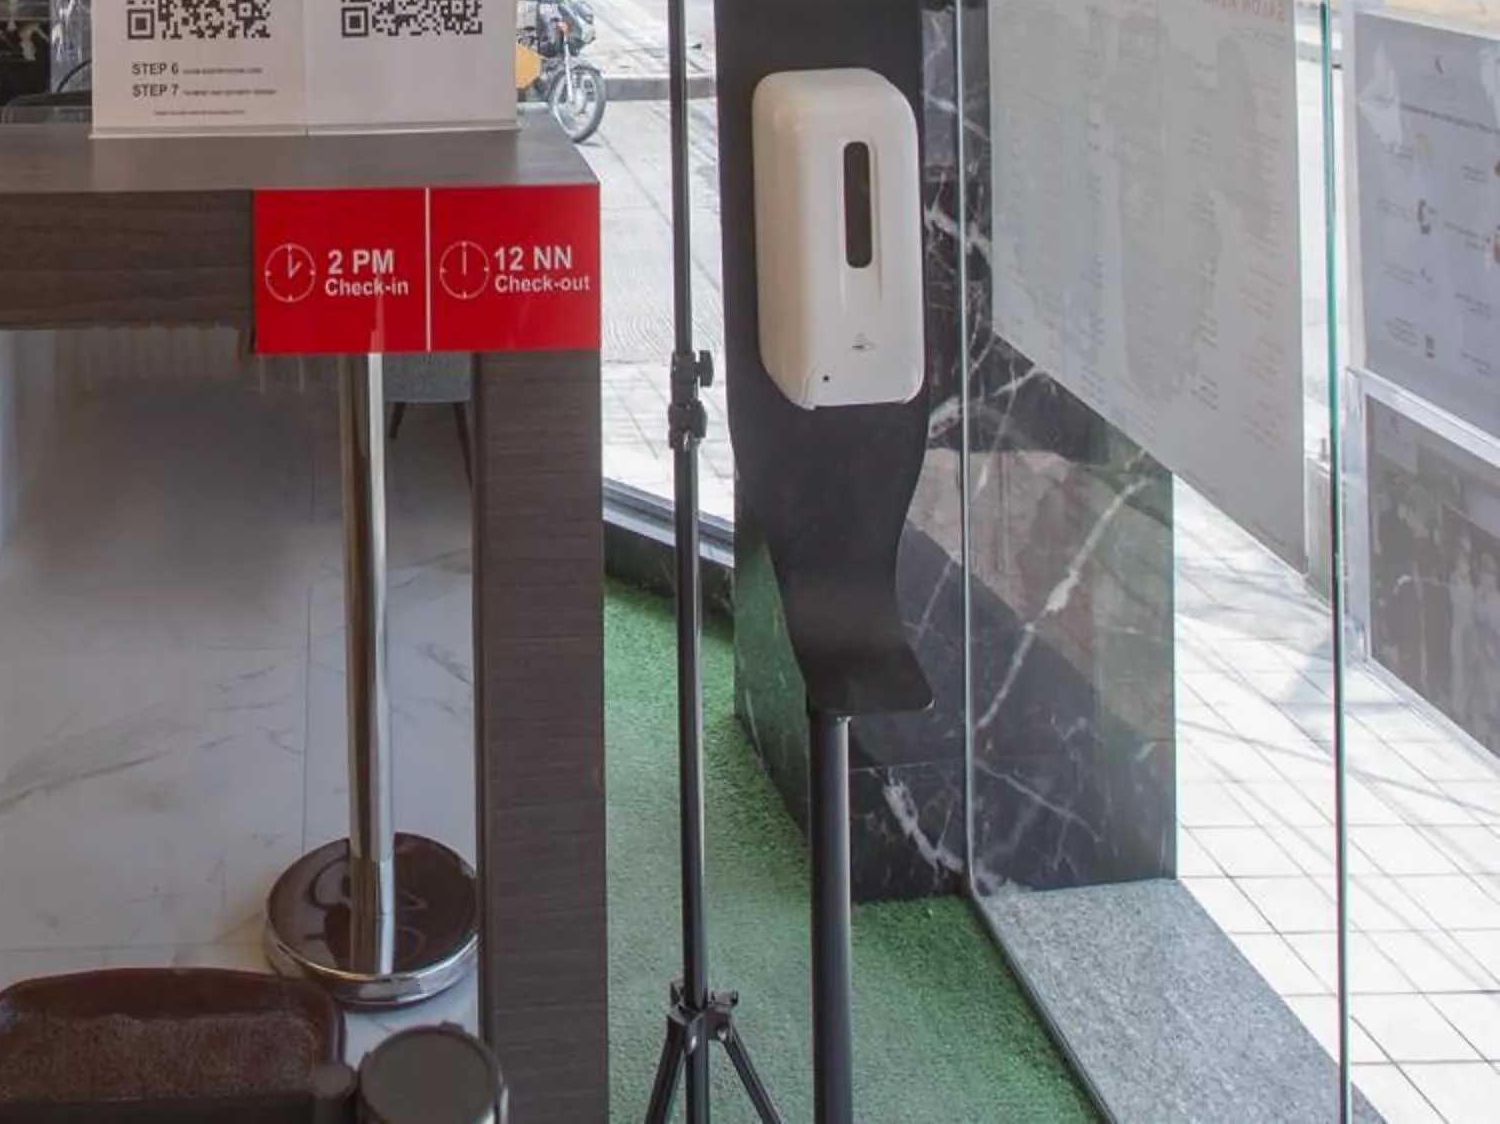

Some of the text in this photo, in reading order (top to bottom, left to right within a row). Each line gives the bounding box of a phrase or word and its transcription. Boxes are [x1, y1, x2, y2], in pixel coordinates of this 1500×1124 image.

[132, 62, 167, 76] STEP
[171, 62, 179, 75] 6
[132, 84, 167, 98] STEP
[171, 83, 178, 96] 7
[327, 249, 395, 274] 2 PM
[494, 246, 573, 272] 12 NN
[325, 276, 409, 297] Check-in
[495, 274, 591, 293] Check-out
